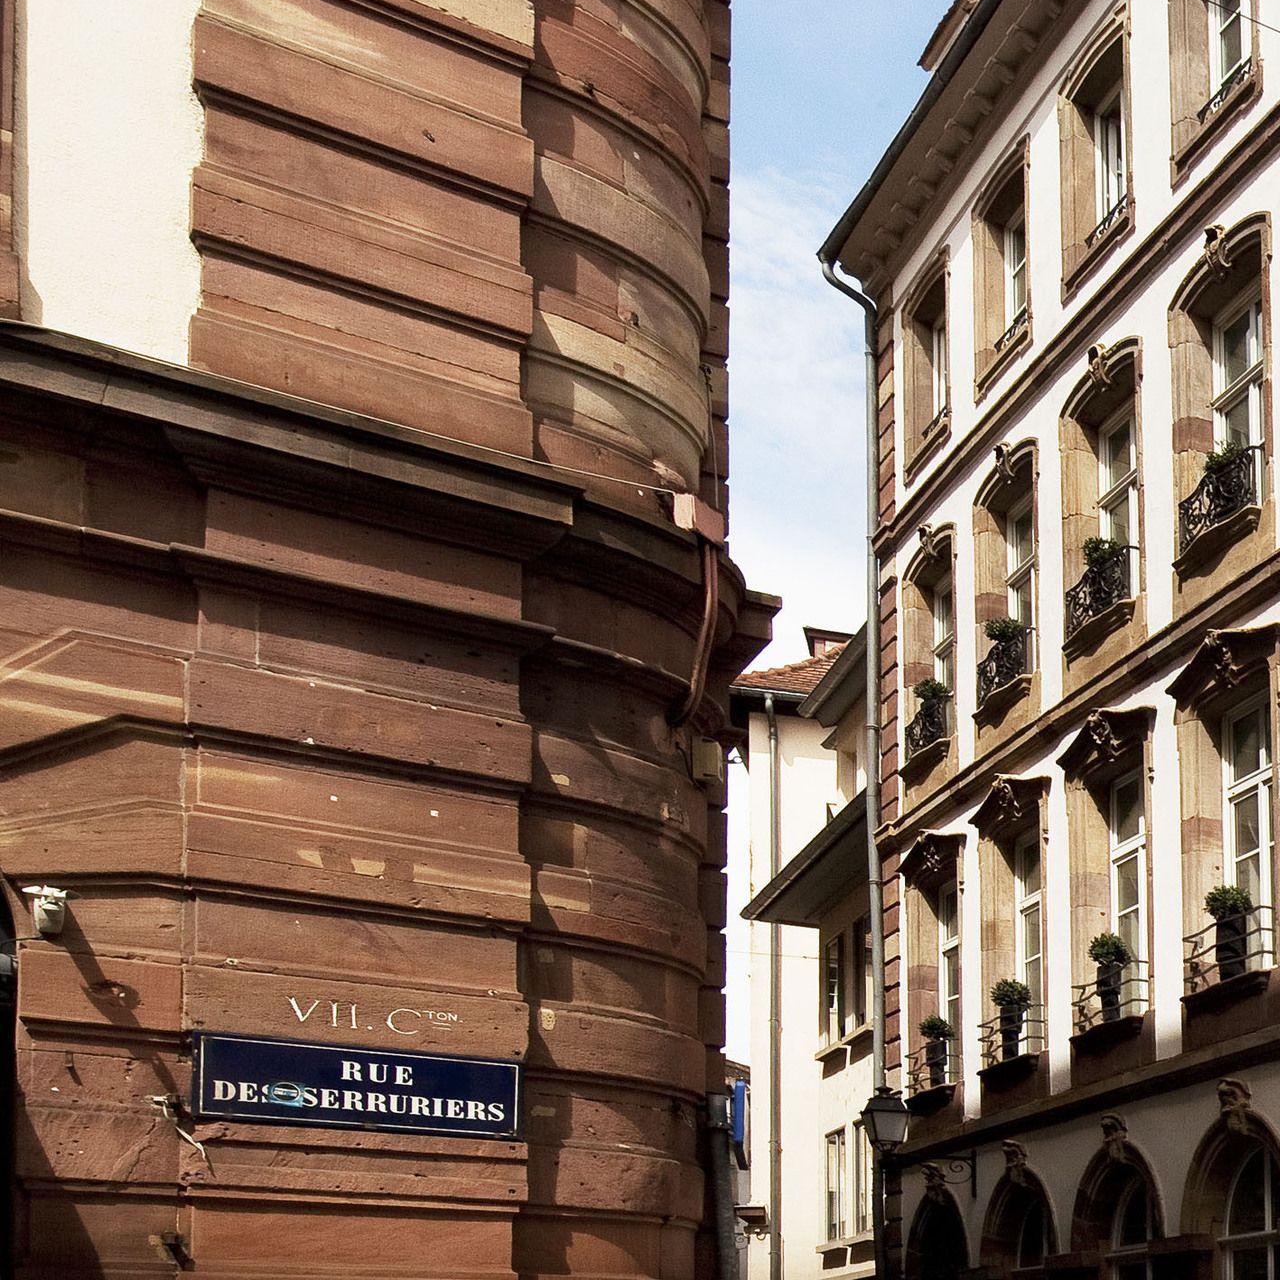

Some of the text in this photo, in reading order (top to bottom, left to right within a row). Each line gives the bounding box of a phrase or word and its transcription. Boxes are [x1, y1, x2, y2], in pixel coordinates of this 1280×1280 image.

[286, 996, 373, 1030] VII.
[340, 1060, 414, 1086] RUE
[302, 1087, 505, 1122] SERRURIERS
